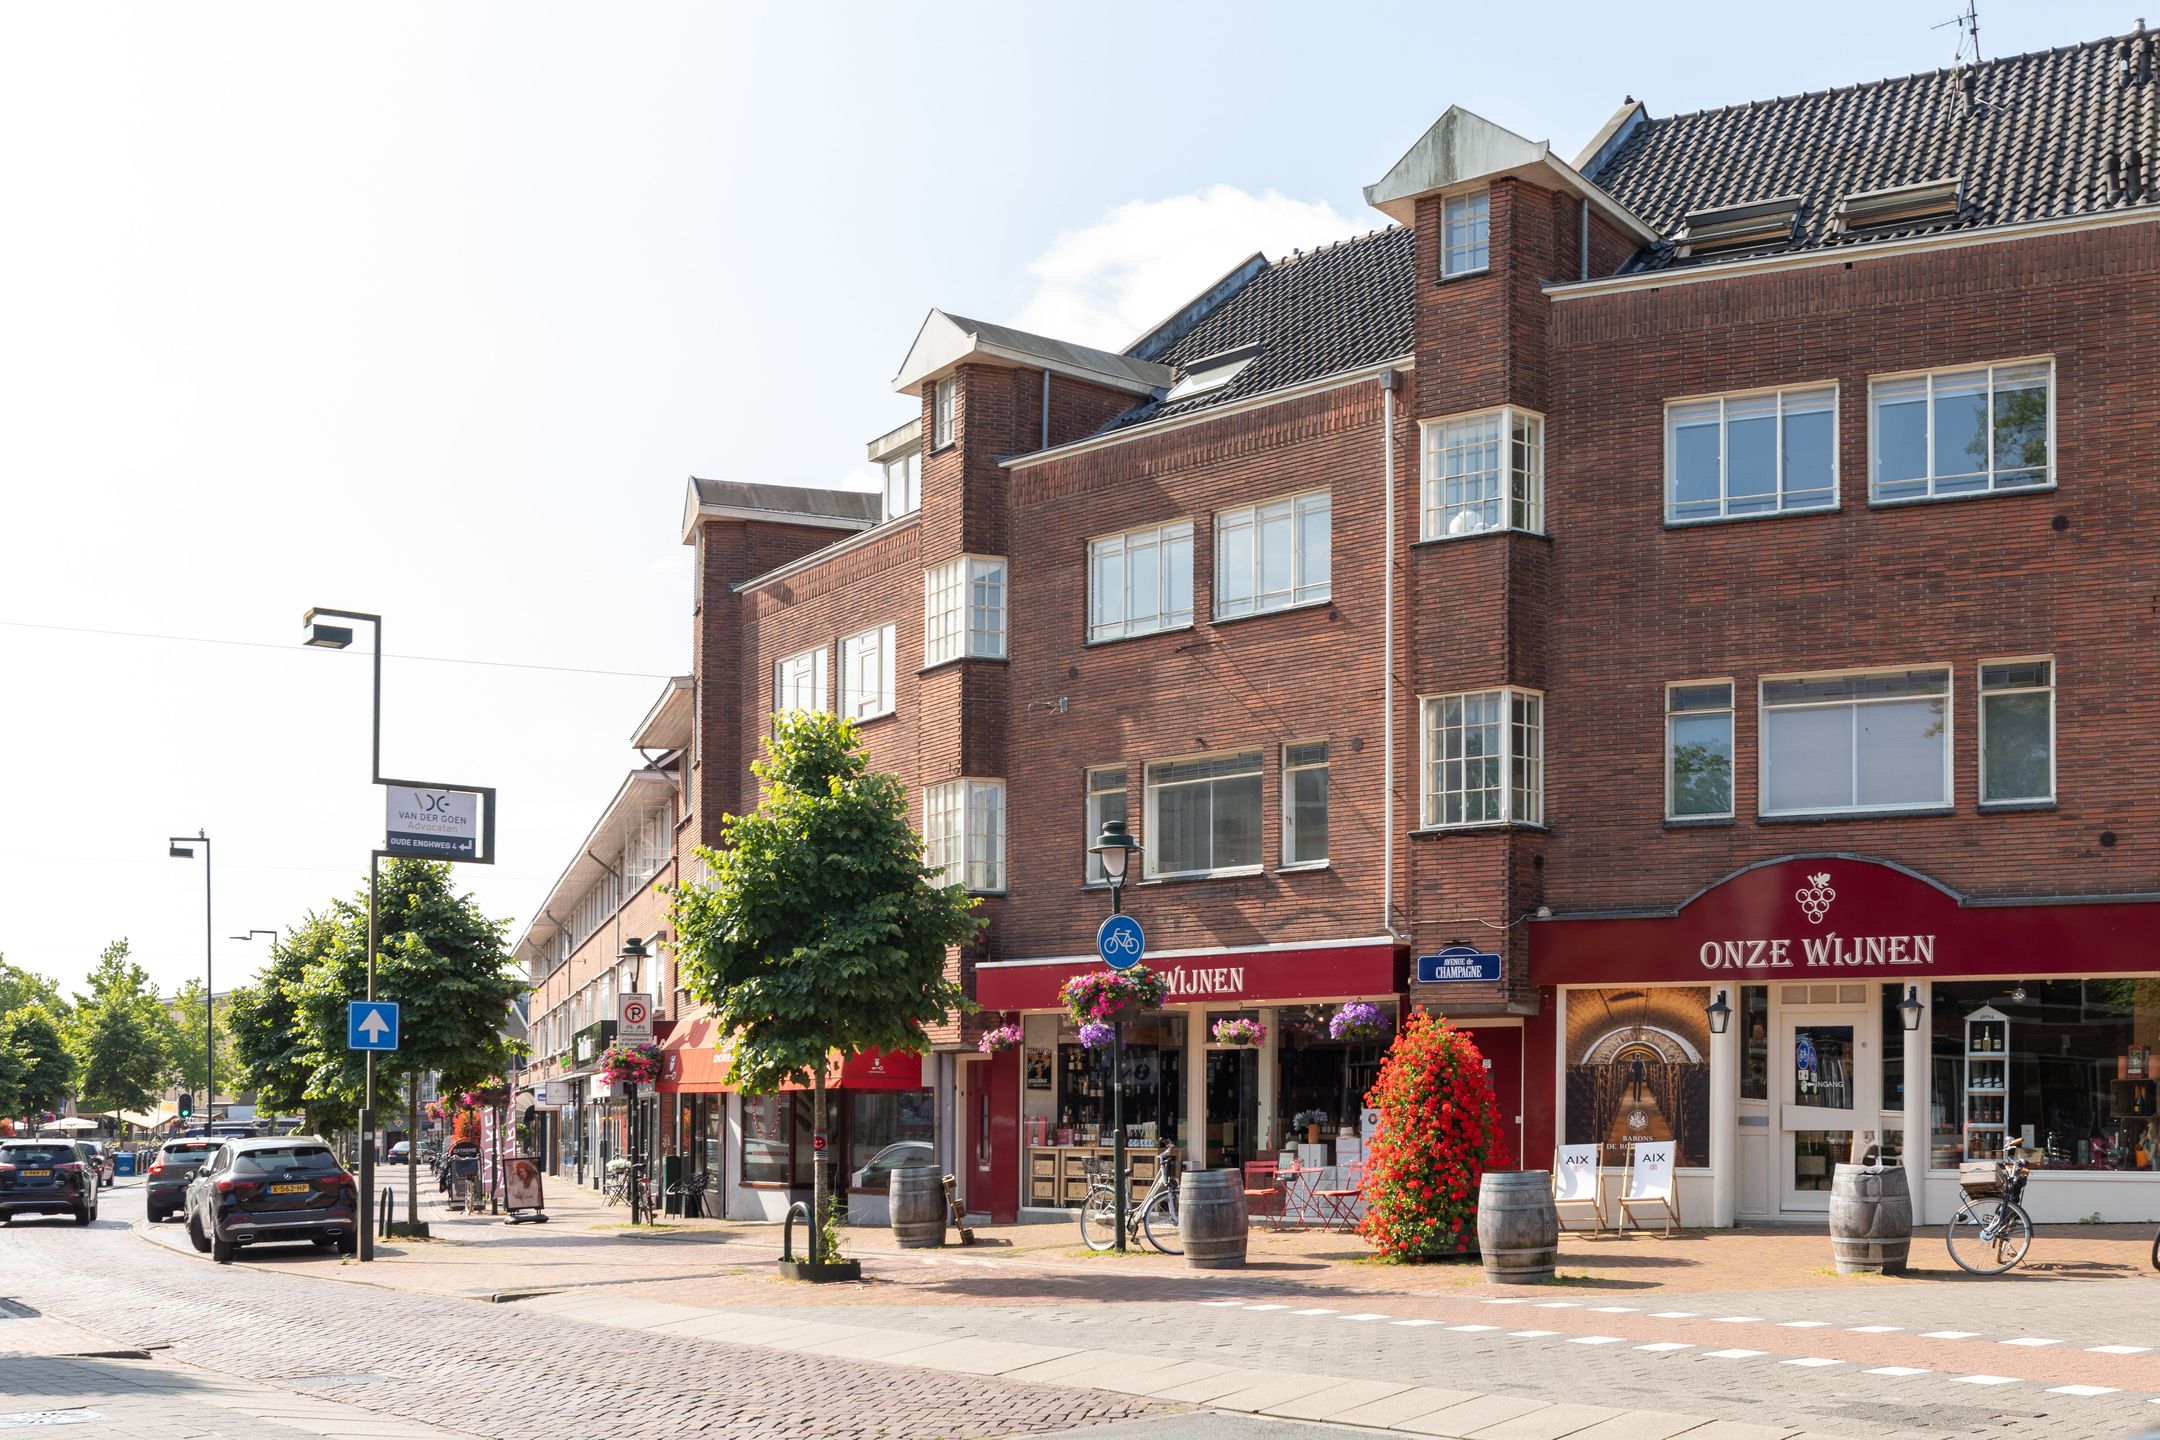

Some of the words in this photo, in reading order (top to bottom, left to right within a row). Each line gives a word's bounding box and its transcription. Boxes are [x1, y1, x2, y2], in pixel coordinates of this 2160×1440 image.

[398, 811, 417, 820] VAN
[420, 813, 438, 822] DER
[441, 815, 467, 824] GOEN
[408, 821, 458, 833] Advocaten
[390, 837, 413, 846] OUDE
[413, 839, 451, 849] ENGHWEG
[1700, 939, 1794, 969] ONZE
[1801, 931, 1936, 967] WIJNEN
[1444, 958, 1466, 966] AVENUE
[1435, 966, 1482, 979] CHAMPAGNE
[1159, 965, 1245, 995] WIJNEN
[1566, 1156, 1589, 1164] AIX
[1642, 1153, 1665, 1162] AIX
[272, 1184, 307, 1193] X-562-HP
